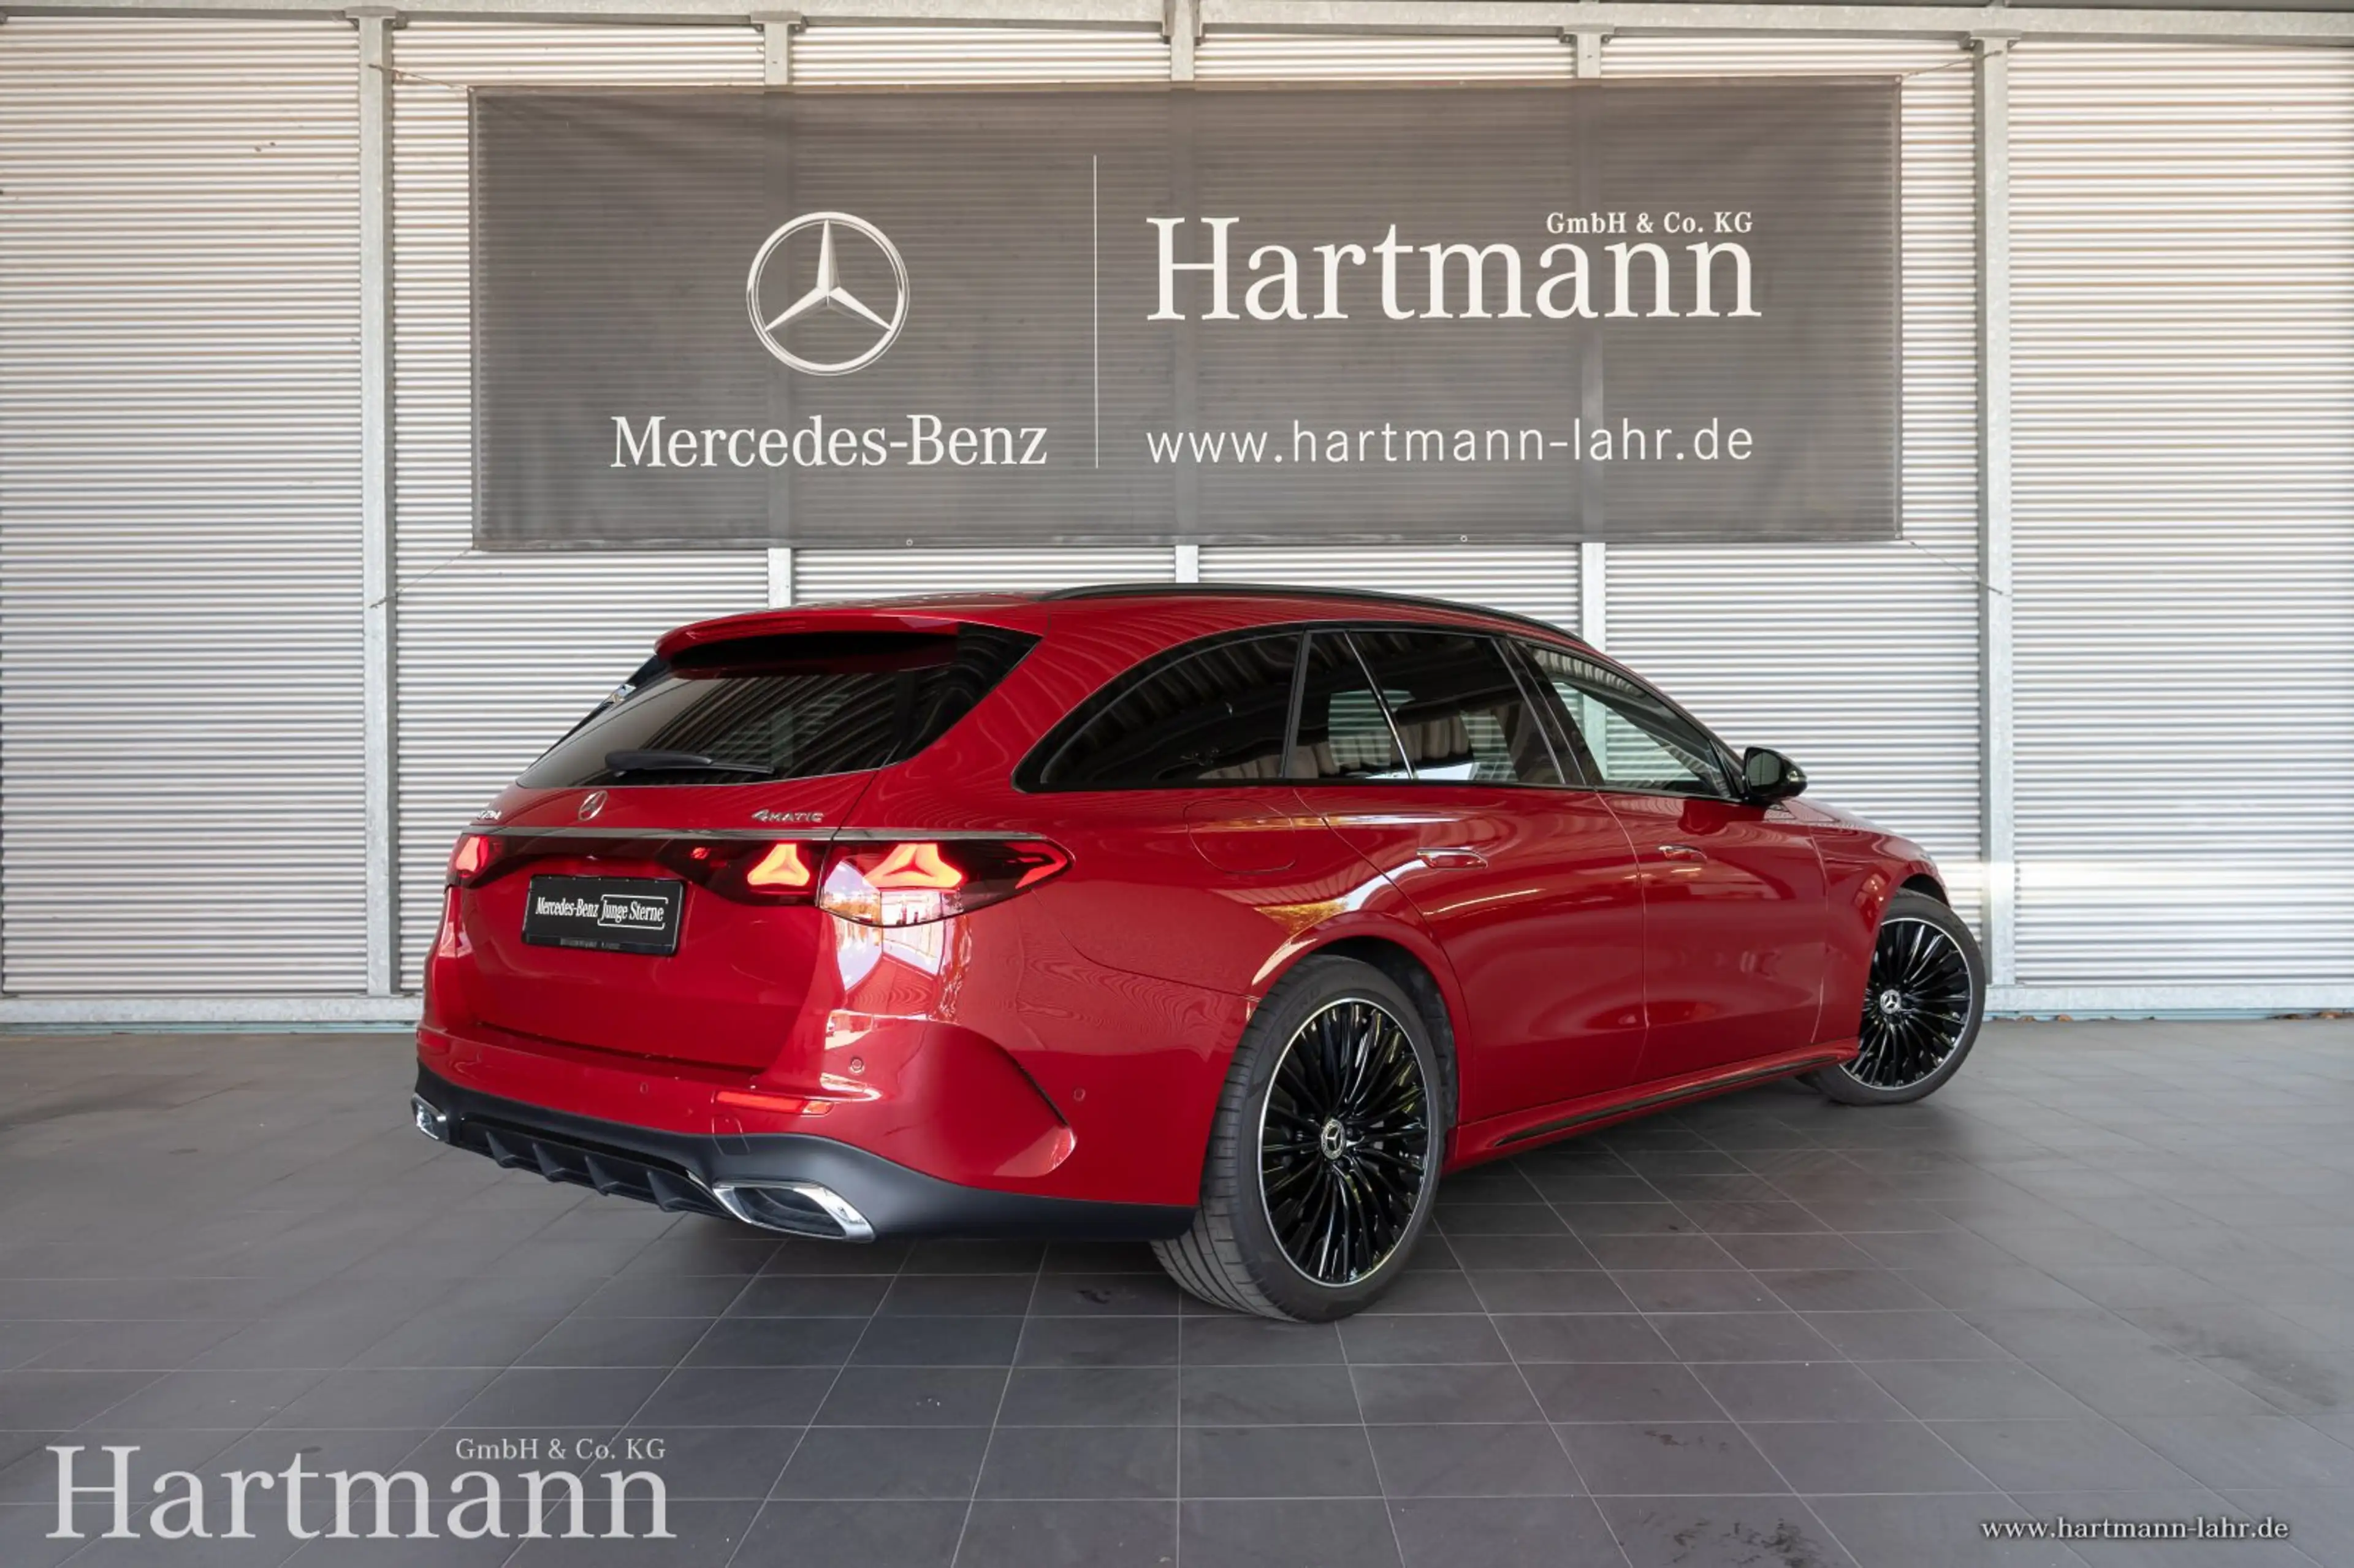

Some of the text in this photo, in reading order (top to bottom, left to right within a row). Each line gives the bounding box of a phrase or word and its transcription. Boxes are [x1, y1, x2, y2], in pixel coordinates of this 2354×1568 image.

[1546, 211, 1753, 234] GmbH & Co. KG
[1146, 217, 1762, 321] Hartmann
[610, 414, 1048, 468] Mercedes-Benz
[1146, 417, 1753, 463] www.hartmann-lahr.de
[535, 896, 665, 923] Mercedes-Benz Junge Sterne
